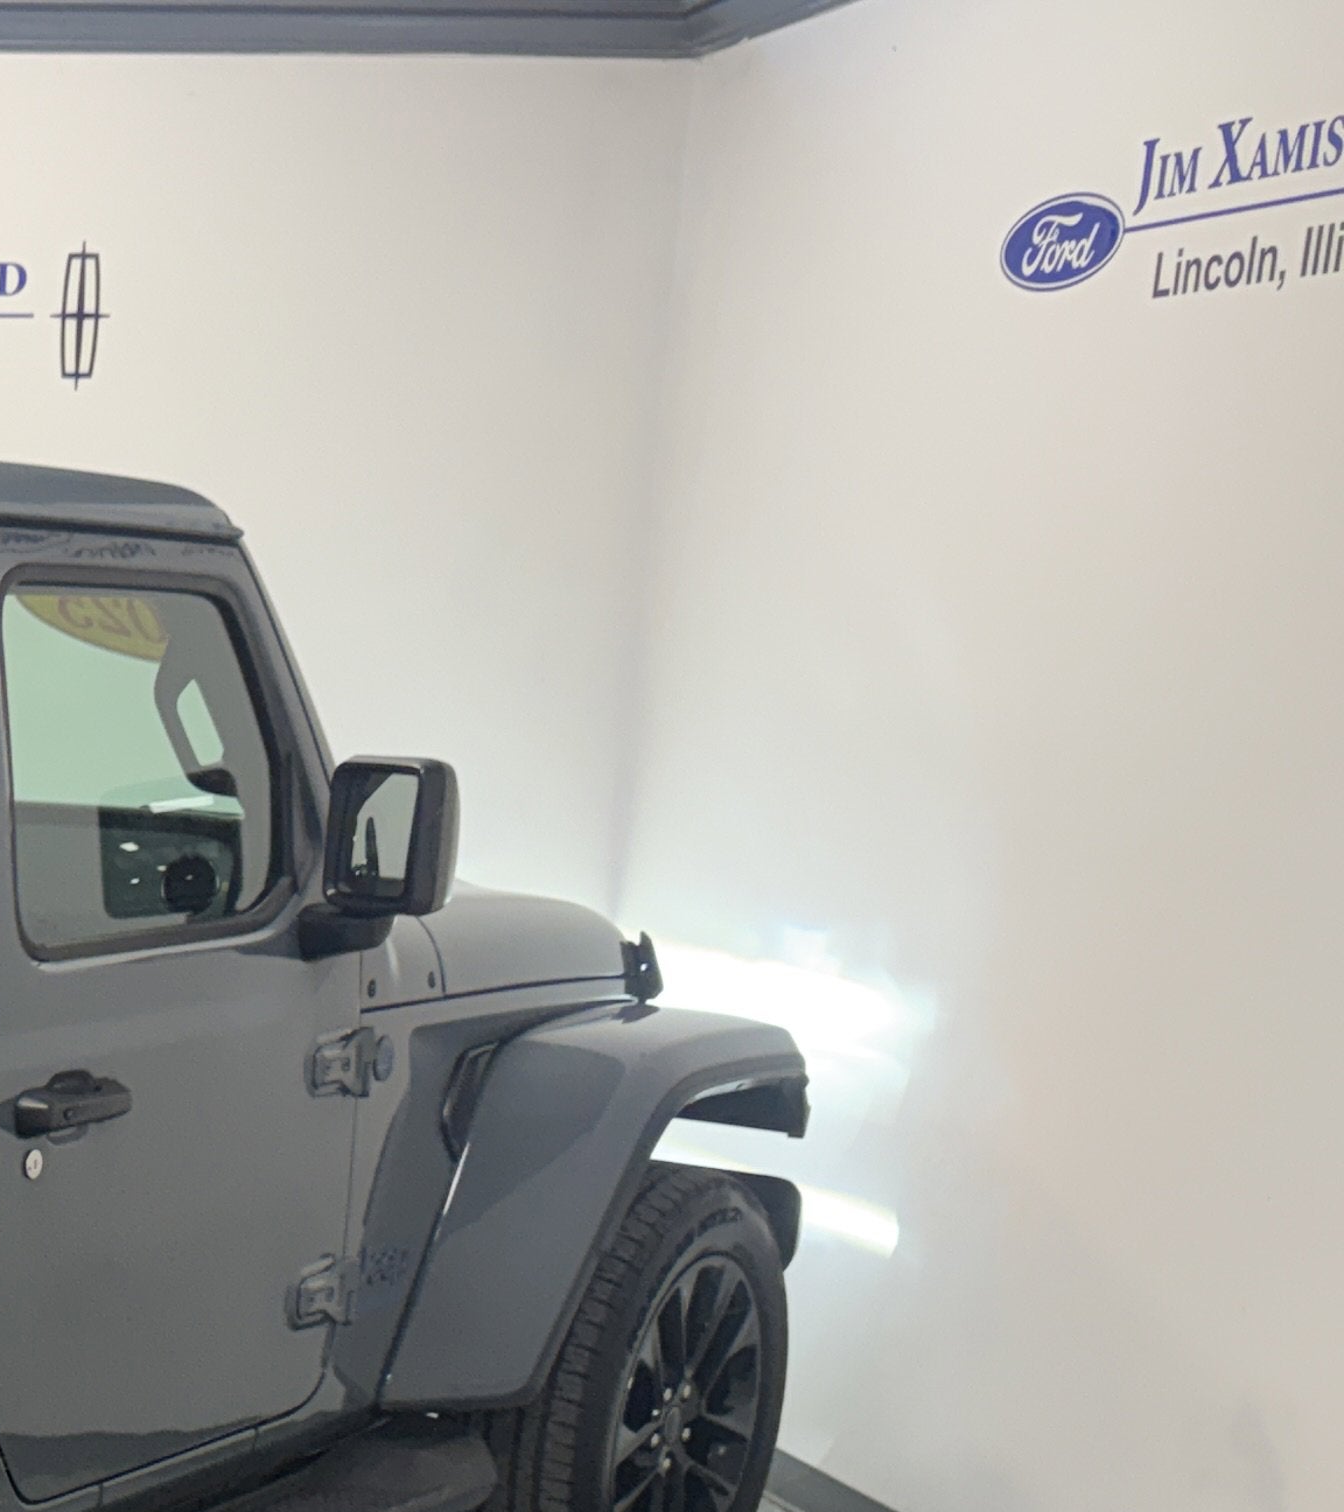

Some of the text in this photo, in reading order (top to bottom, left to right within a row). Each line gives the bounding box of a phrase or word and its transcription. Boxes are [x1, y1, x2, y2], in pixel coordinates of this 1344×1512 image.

[1132, 113, 1344, 216] JIM XAMIS
[1021, 212, 1101, 277] Ford
[1151, 234, 1287, 299] Lincoln,
